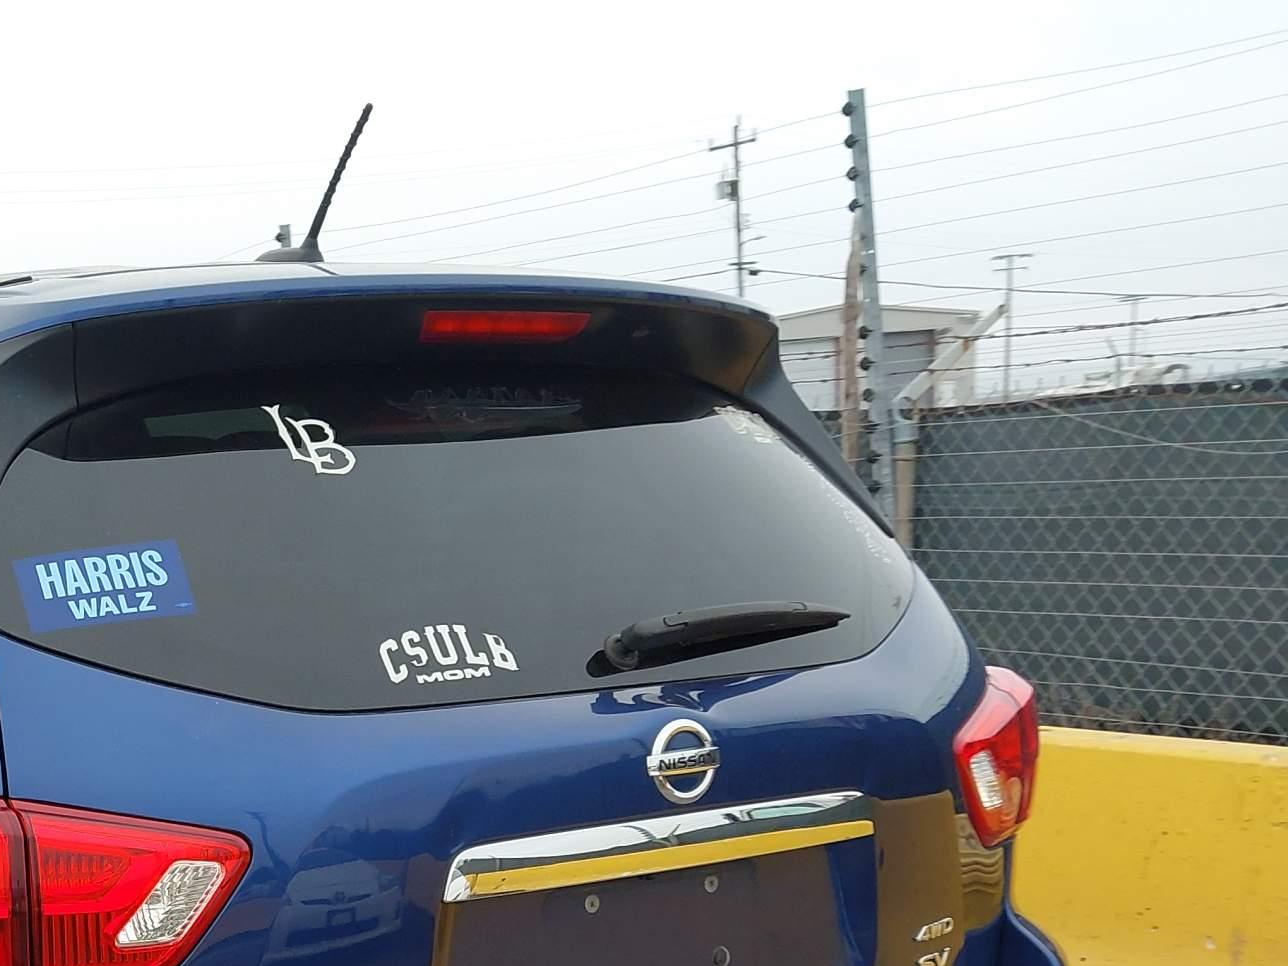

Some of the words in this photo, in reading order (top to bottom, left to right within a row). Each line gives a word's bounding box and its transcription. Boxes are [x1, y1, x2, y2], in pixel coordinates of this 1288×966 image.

[261, 404, 356, 475] LB
[36, 550, 168, 600] HARRIS
[68, 592, 157, 620] WALZ
[380, 624, 520, 683] CSULB
[416, 667, 491, 684] MOM
[915, 917, 954, 941] 4WD
